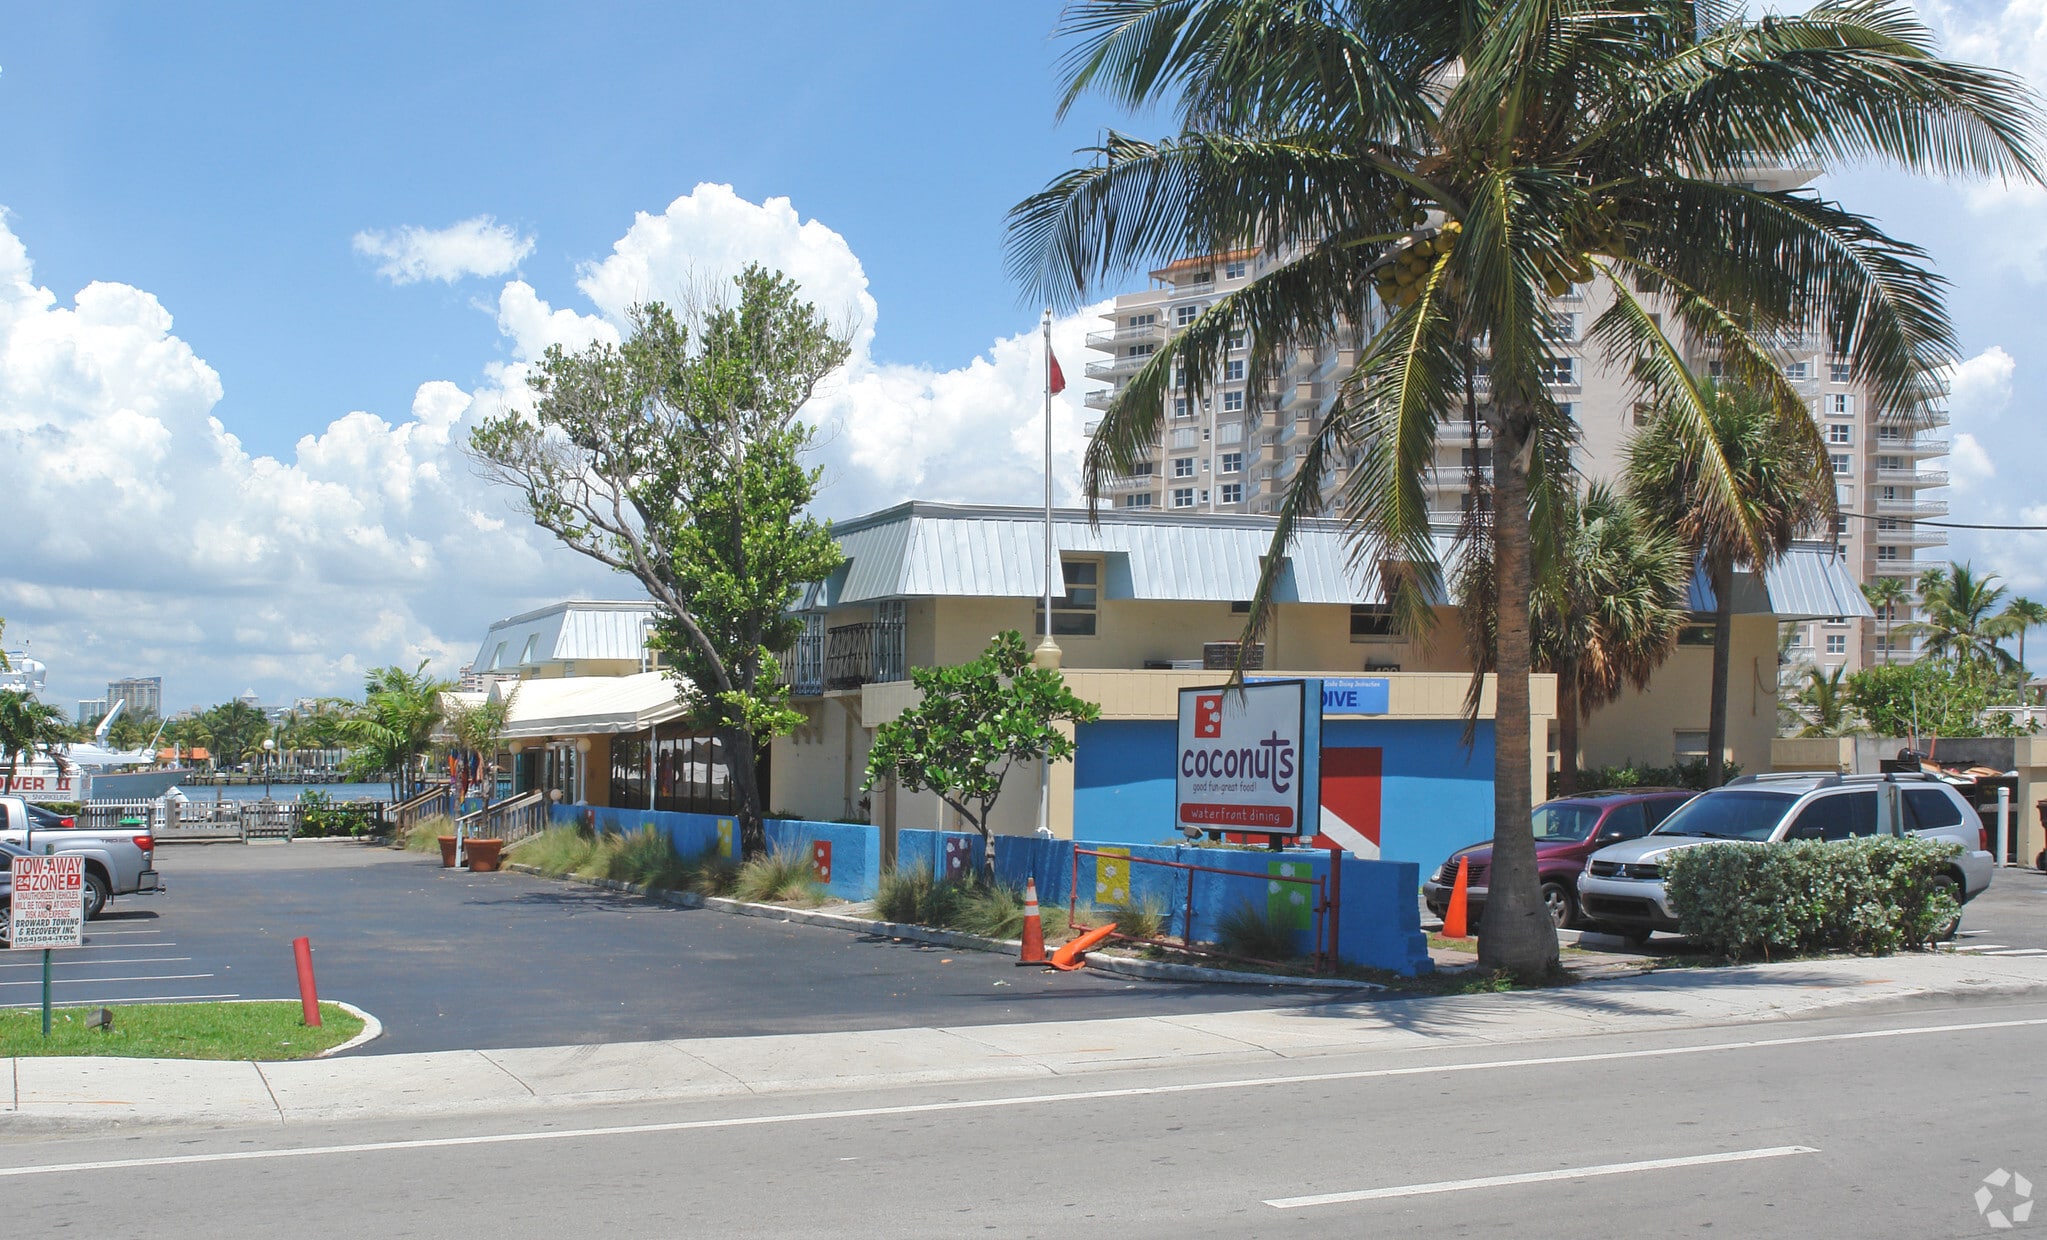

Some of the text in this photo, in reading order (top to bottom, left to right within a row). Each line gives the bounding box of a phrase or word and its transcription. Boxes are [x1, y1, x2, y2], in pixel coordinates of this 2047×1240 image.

[1182, 731, 1294, 794] coconuts
[1193, 782, 1207, 794] good
[1191, 807, 1280, 824] waterfront dining
[16, 858, 82, 874] TOW-AWAY
[17, 875, 77, 890] 24 ZONE 7
[18, 891, 78, 900] UNAUTHORIZED VEHICLES
[15, 901, 26, 909] WILL
[27, 901, 34, 909] BE
[25, 910, 70, 918] RISK AND EXPENSE
[15, 918, 79, 928] BROWARD TOWING
[26, 927, 61, 935] RECOVERY
[62, 926, 76, 934] INC.
